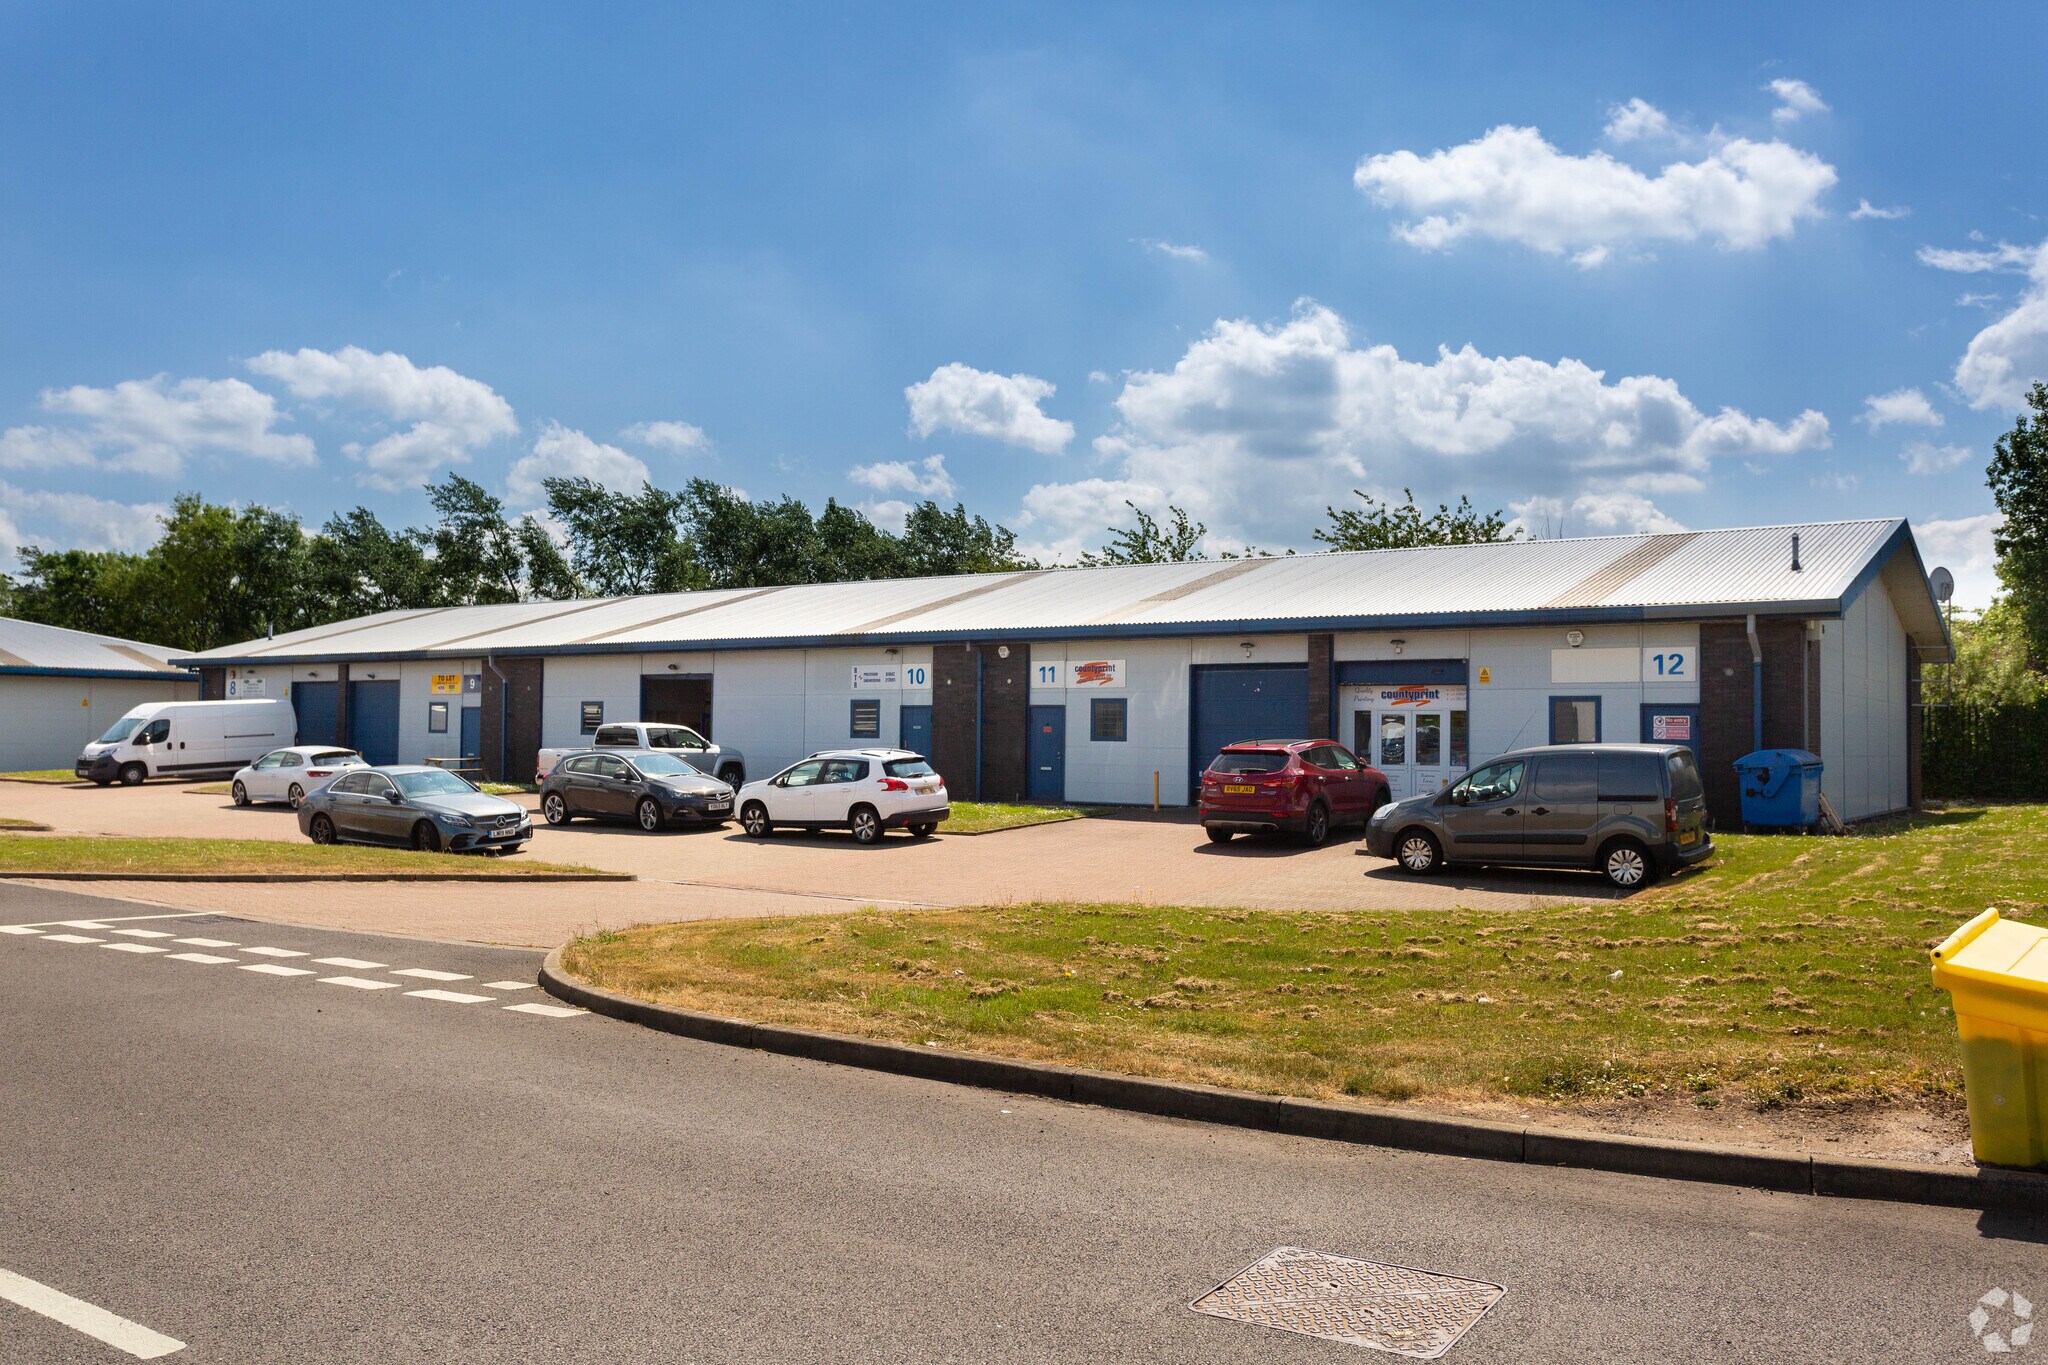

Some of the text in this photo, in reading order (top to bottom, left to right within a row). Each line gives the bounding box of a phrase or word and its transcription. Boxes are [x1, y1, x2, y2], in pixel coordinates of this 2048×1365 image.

[1653, 653, 1684, 675] 12
[907, 668, 925, 685] 10
[1039, 666, 1056, 683] 11
[230, 681, 236, 695] 8
[469, 679, 475, 689] 9
[1353, 695, 1375, 703] Printing
[1381, 688, 1440, 701] countyprint
